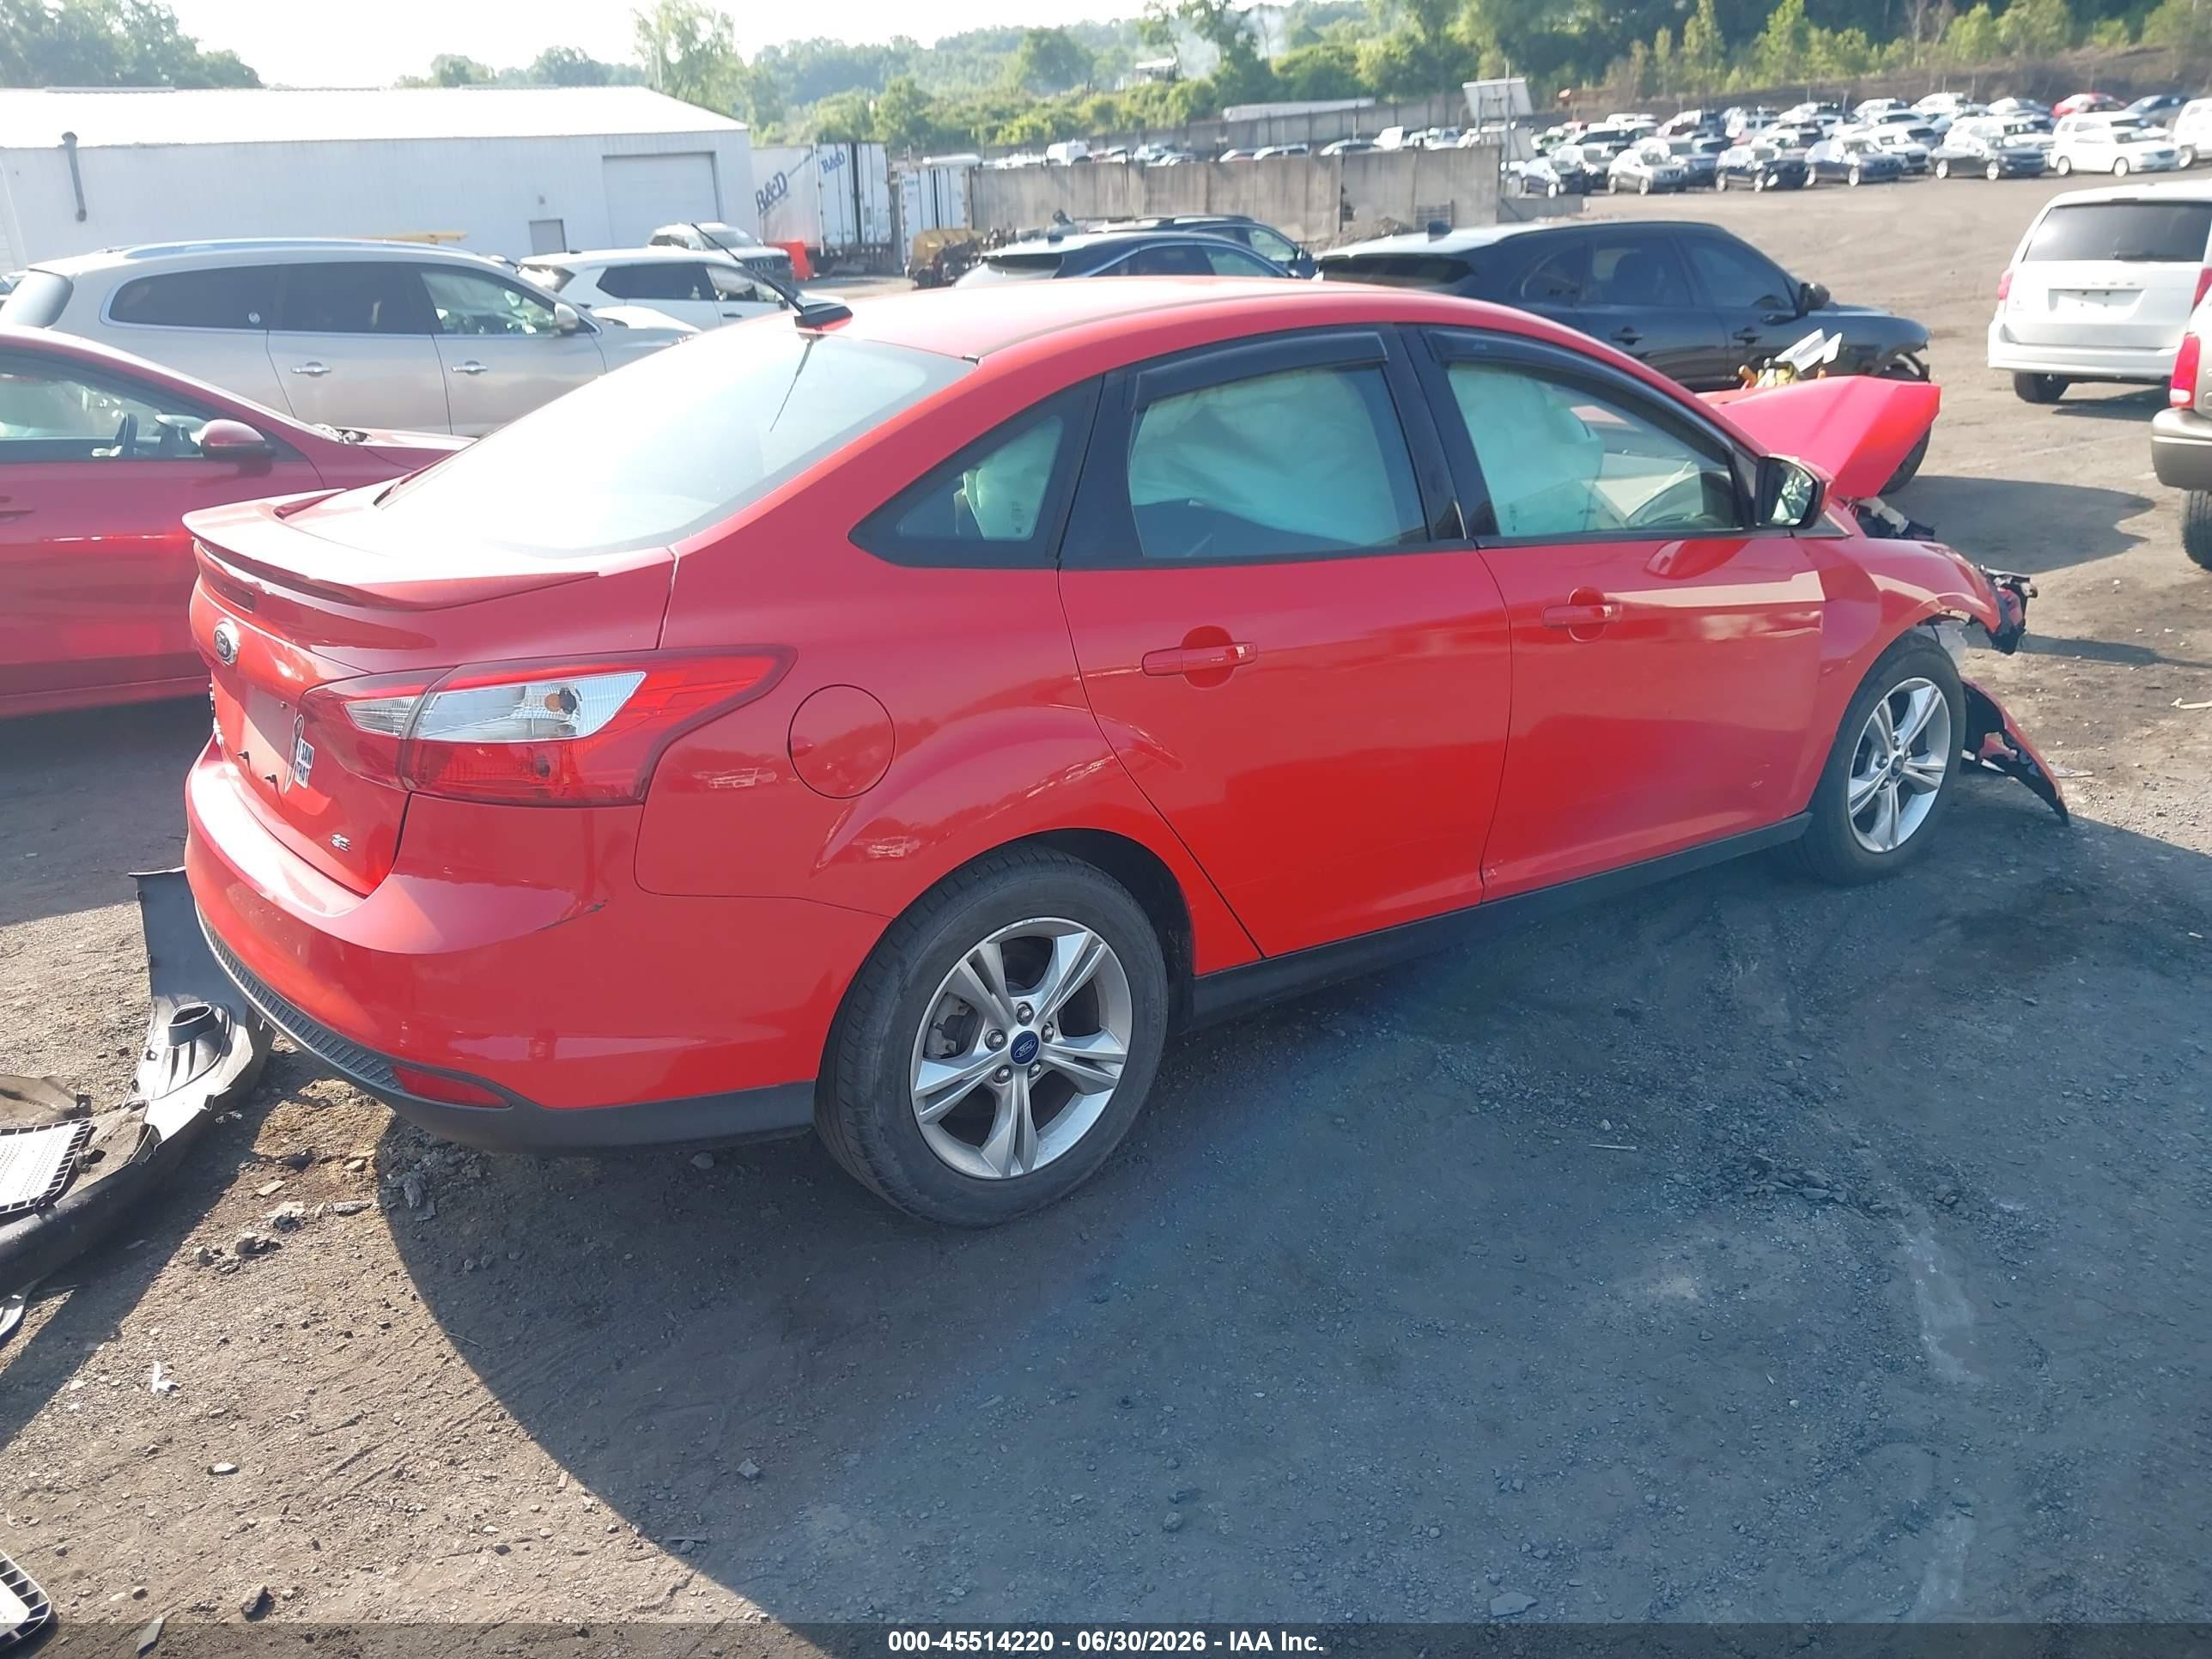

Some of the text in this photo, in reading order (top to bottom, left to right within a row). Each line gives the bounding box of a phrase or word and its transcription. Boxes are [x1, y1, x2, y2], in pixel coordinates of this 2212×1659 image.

[301, 742, 314, 767] SAW
[295, 761, 309, 785] THAT
[1016, 1040, 1036, 1057] Ford
